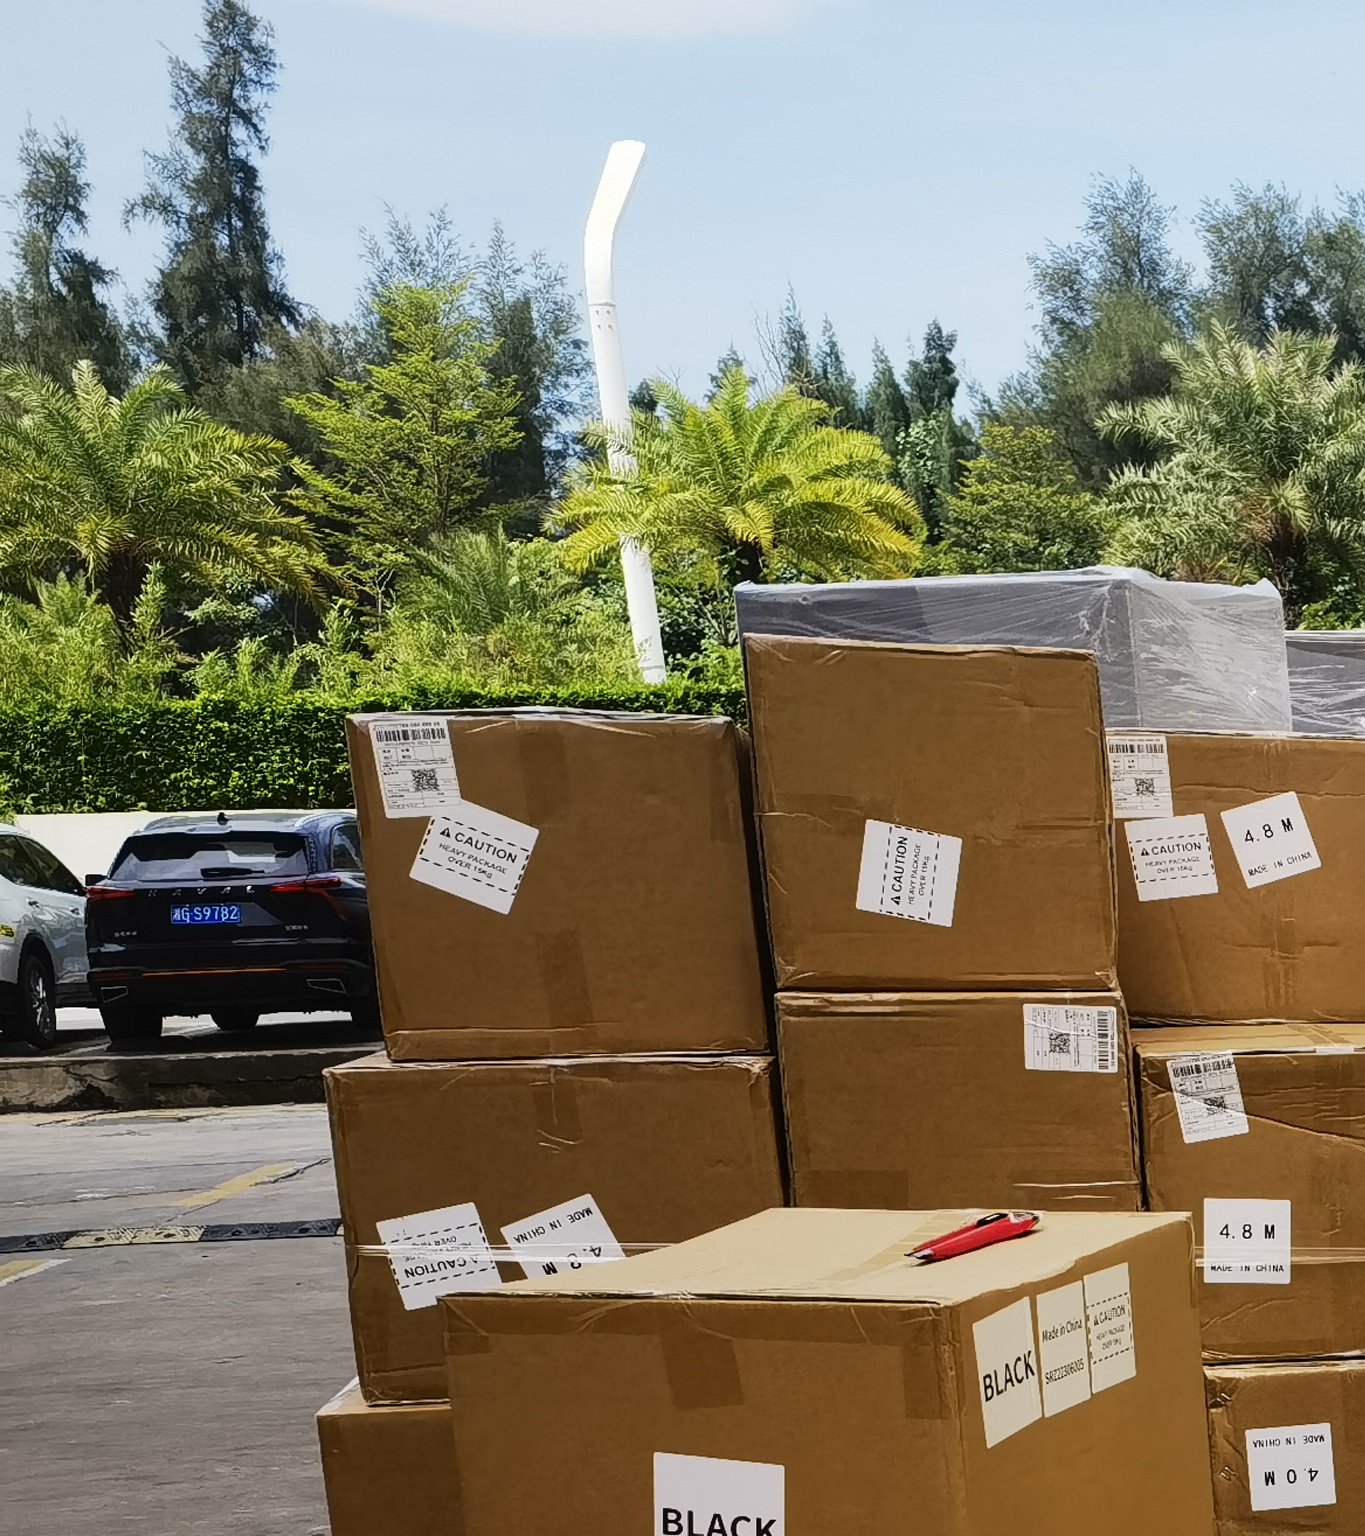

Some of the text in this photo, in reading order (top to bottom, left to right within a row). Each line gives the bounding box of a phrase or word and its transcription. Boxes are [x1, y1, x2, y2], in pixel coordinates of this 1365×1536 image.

[1244, 817, 1294, 843] 4.8 M
[454, 832, 518, 864] CAUTION
[1150, 842, 1203, 856] CAUTION
[891, 836, 908, 893] CAUTION
[566, 1206, 594, 1224] MADE
[513, 1226, 547, 1244] CHINA
[1219, 1223, 1275, 1240] 4.8 M
[403, 1257, 468, 1278] CAUTION
[982, 1350, 1035, 1402] BLACK
[1252, 1438, 1281, 1448] CHINA
[1302, 1435, 1325, 1445] MADE
[1264, 1468, 1319, 1487] 4.0 M
